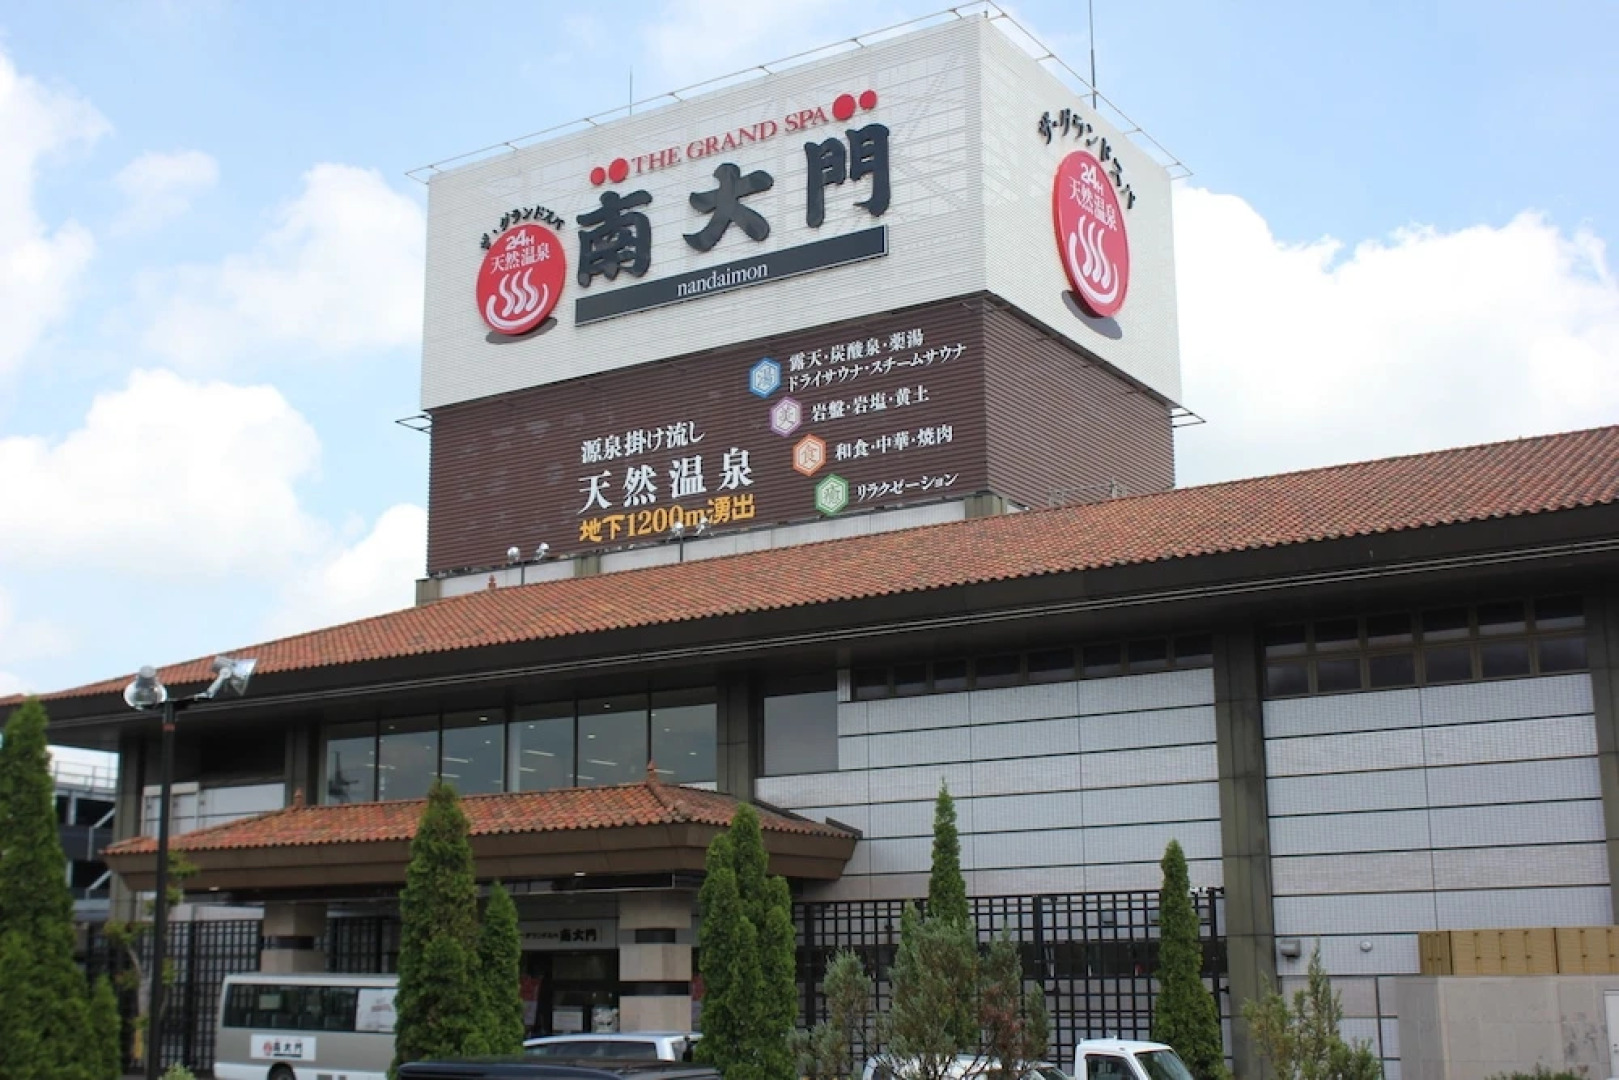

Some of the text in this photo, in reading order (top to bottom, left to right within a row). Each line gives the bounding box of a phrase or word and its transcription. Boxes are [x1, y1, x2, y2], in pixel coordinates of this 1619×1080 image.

[631, 106, 829, 174] THE GRAND SPA
[1081, 162, 1105, 197] 24H
[576, 123, 891, 288] 南大門
[1068, 176, 1118, 232] 天然温泉
[490, 242, 550, 274] 天然温泉
[505, 229, 535, 251] 24H
[676, 261, 769, 297] nandaimon
[789, 343, 967, 393] ドライサウナ・スチームサウナ
[811, 385, 930, 422] 岩盤・岩塩・黄土
[581, 421, 705, 464] 源泉掛け流し
[835, 424, 953, 461] 和食・中華・焼肉
[577, 447, 754, 514] 天然温泉
[857, 473, 960, 503] リラクゼーション
[579, 493, 755, 543] 地下1200m湧出
